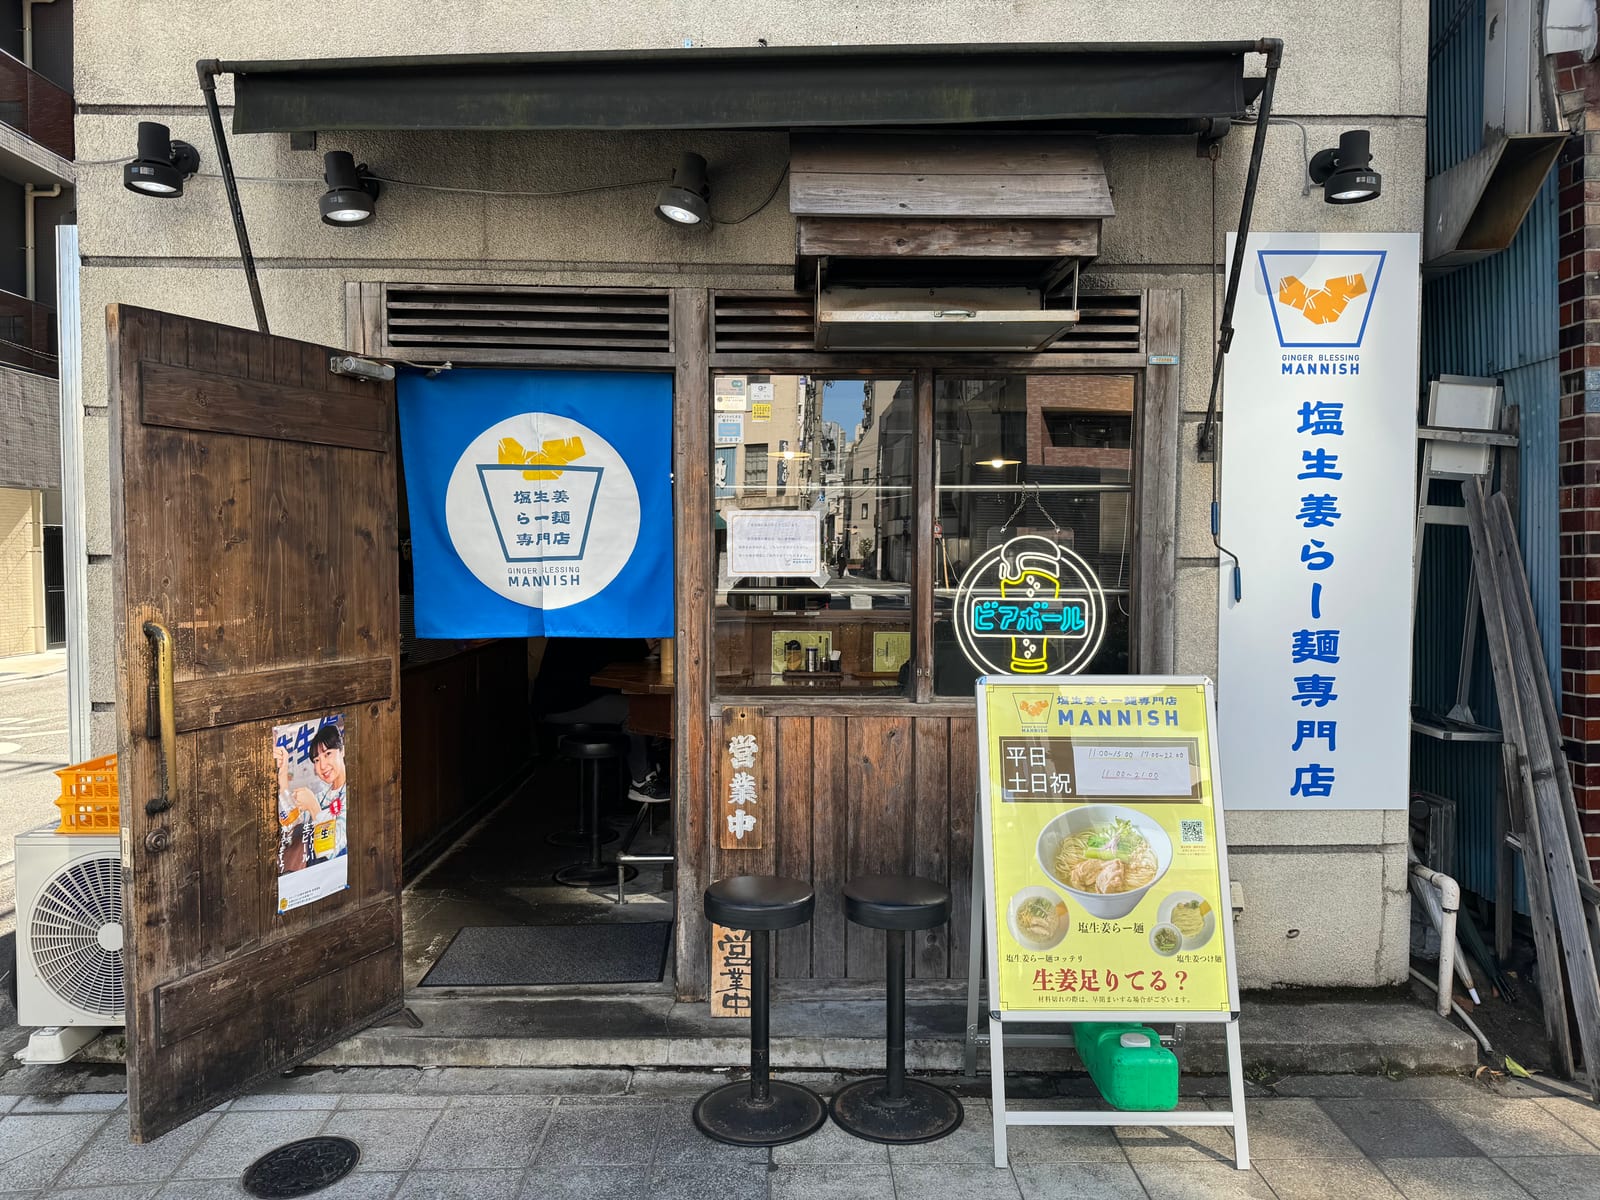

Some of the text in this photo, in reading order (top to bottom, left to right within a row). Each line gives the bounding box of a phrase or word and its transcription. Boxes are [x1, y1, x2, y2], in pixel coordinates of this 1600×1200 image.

[1282, 363, 1360, 375] MANNISH
[513, 490, 570, 504] 塩生姜
[517, 511, 571, 525] らー麺
[516, 532, 571, 546] 専門店
[507, 567, 538, 575] GINGER
[508, 575, 581, 587] MANNISH
[1290, 401, 1344, 797] 塩生姜らー麺専門店
[974, 602, 1085, 631] ビアボール
[1058, 709, 1179, 726] MANNISH
[1006, 747, 1046, 767] 平日
[727, 734, 758, 840] 営業中
[1007, 773, 1072, 794] 土日祝
[321, 829, 329, 839] 生
[1078, 922, 1144, 934] 塩生姜らー麺
[1176, 954, 1222, 963] 塩生姜つけ麺
[1032, 968, 1188, 992] 生姜足りてる？
